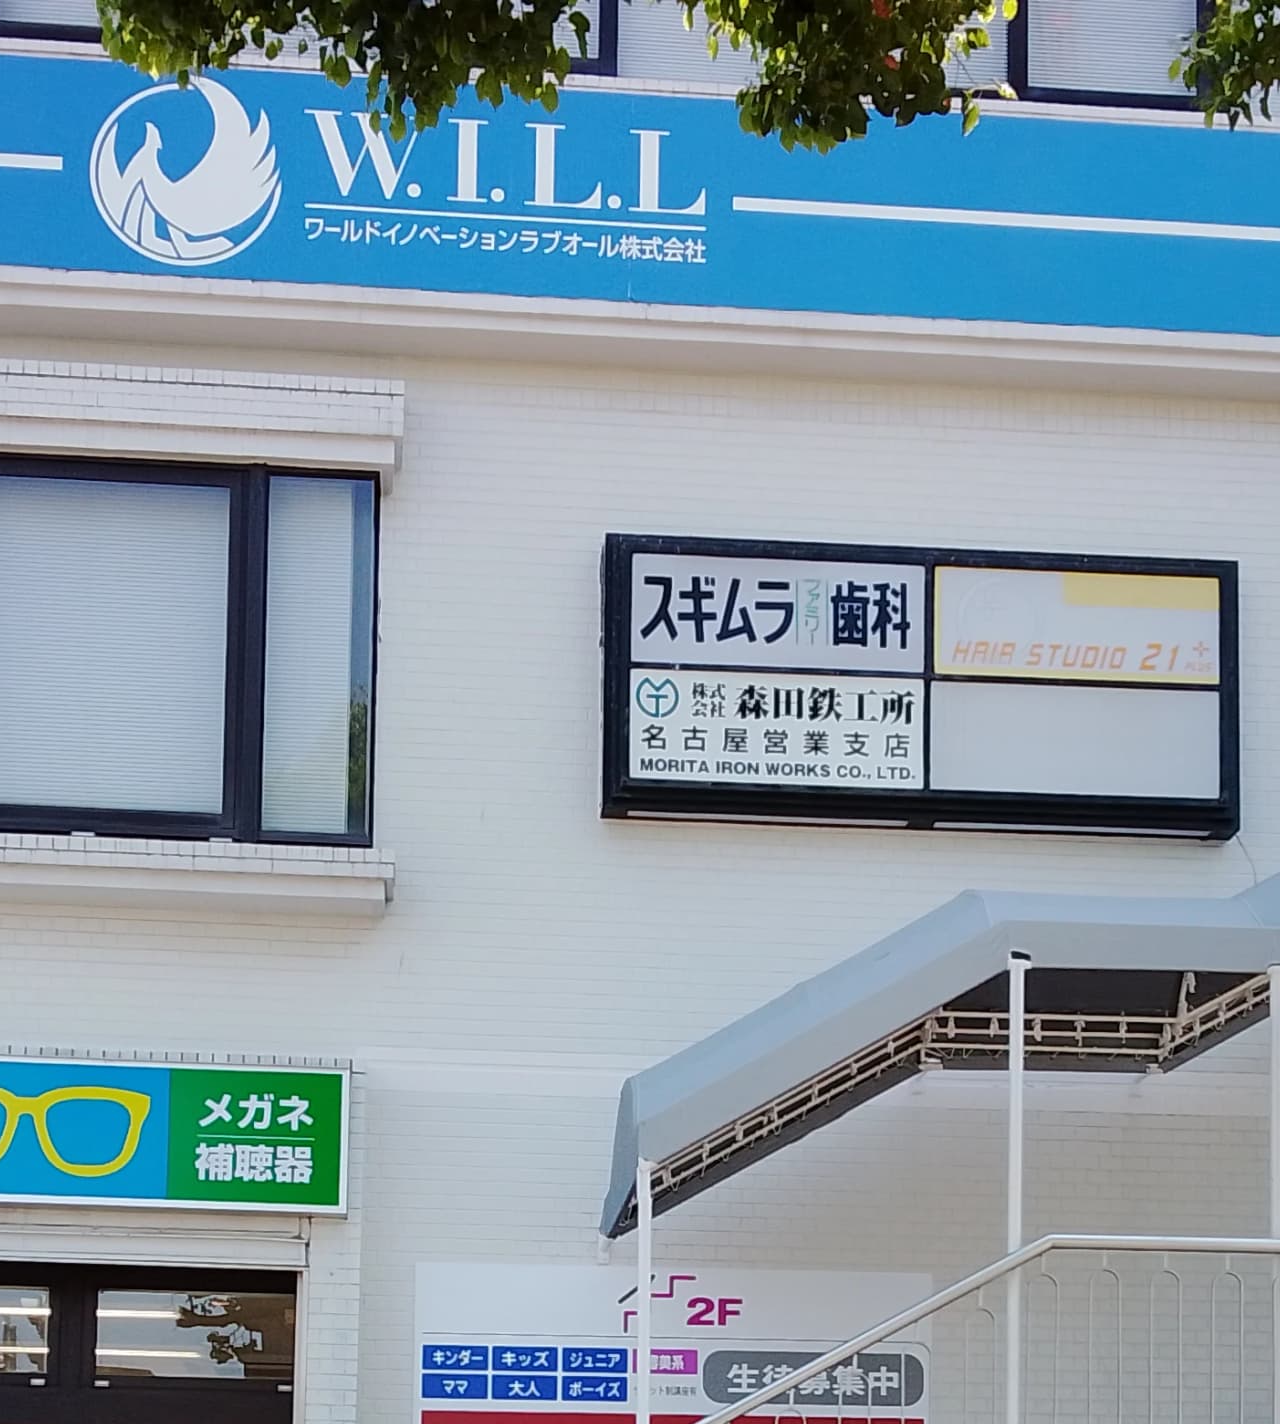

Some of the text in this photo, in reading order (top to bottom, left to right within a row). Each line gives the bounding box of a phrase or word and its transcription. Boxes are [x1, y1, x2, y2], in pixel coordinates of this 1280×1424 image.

[304, 218, 706, 264] ワールドイノベーションラブオール株式会社
[640, 574, 793, 646] スギムラ
[831, 580, 911, 649] 歯科
[952, 640, 1179, 671] HAIR STUDIO 21
[734, 685, 916, 725] 森田鉄工所
[641, 724, 910, 758] 名古屋営業支店
[640, 758, 710, 774] MORITA
[716, 760, 760, 775] IRON
[765, 762, 830, 778] WORKS
[877, 766, 916, 780] LTD.
[198, 1093, 314, 1131] メガネ
[194, 1143, 313, 1184] 補聴器
[686, 1297, 743, 1326] 2F
[432, 1350, 484, 1365] キンダー
[501, 1351, 549, 1368] キッズ
[569, 1352, 620, 1369] ジュニア
[442, 1379, 468, 1395] ママ
[508, 1380, 540, 1397] 大人
[569, 1381, 621, 1398] ボーイズ
